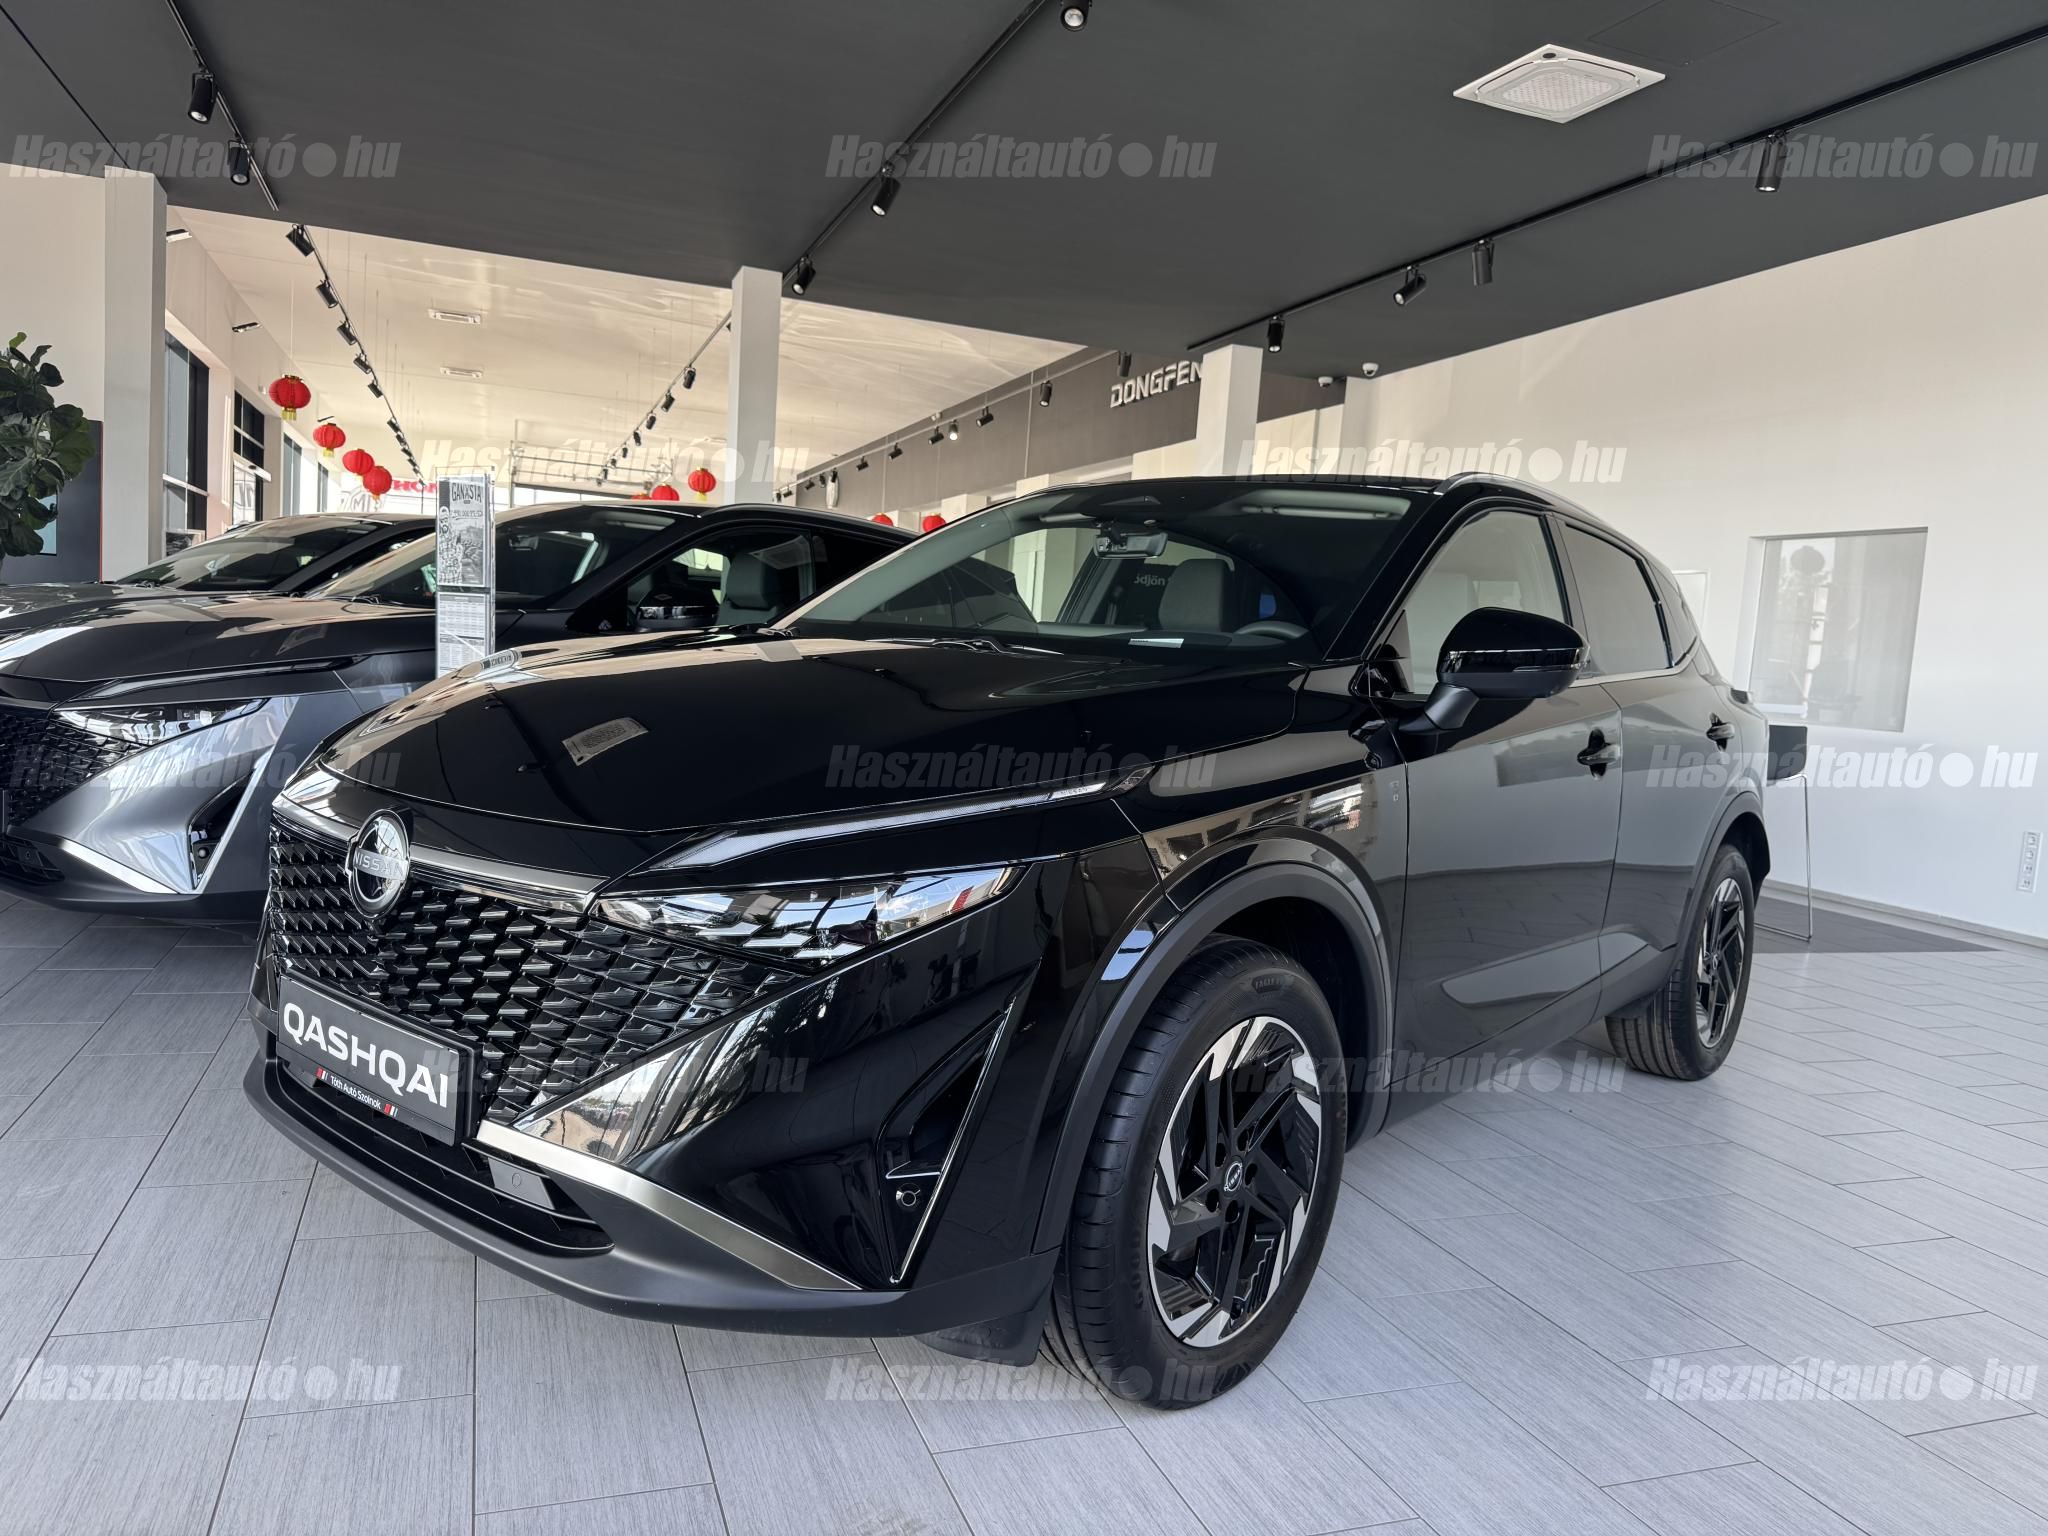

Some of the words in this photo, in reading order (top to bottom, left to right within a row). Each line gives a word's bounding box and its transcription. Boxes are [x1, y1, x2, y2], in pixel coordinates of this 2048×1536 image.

[1110, 360, 1202, 408] DONGFEN
[353, 849, 404, 878] NISSAN
[283, 1002, 449, 1109] QASHQAI
[330, 1075, 343, 1090] Tóth
[342, 1083, 358, 1098] Autó
[357, 1090, 382, 1110] Szolnok
